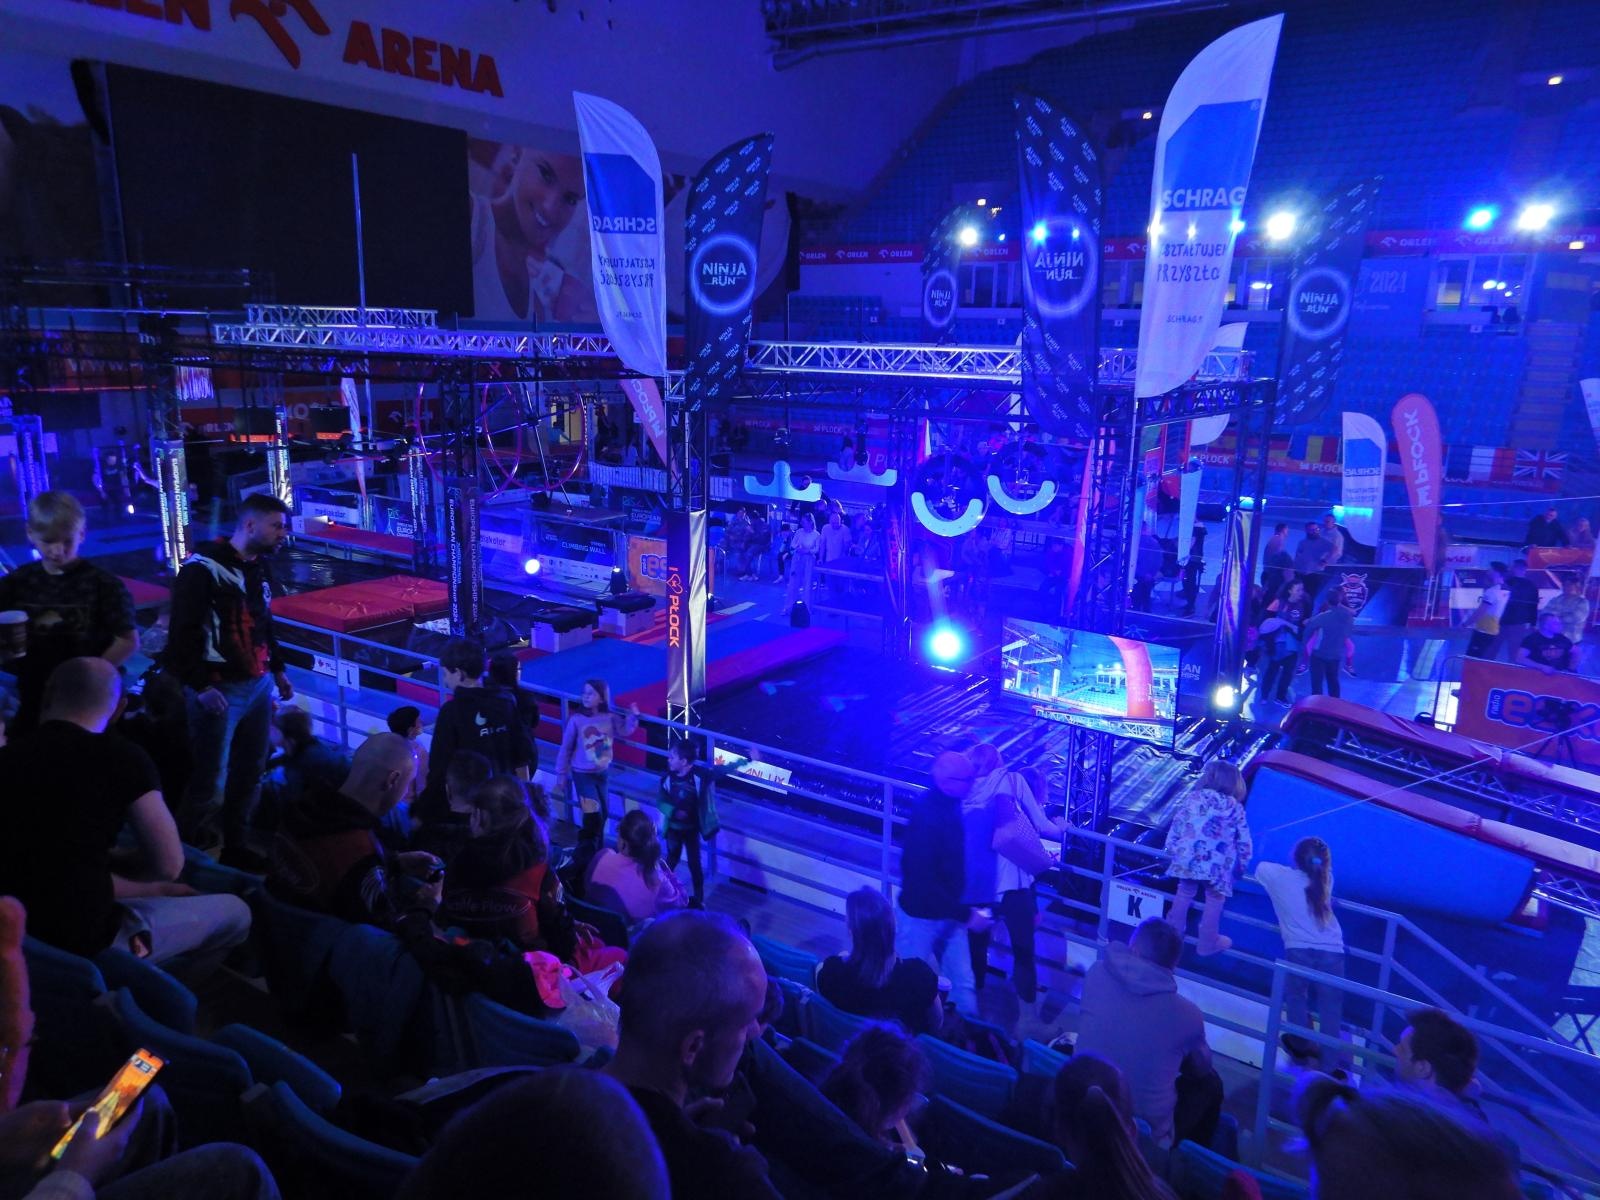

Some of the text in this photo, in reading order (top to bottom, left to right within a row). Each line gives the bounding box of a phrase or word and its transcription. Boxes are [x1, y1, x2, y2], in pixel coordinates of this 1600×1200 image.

[343, 20, 505, 98] ARENA
[1162, 187, 1245, 208] SCHRAG
[702, 262, 747, 276] NINJA
[712, 277, 736, 287] RUN
[1300, 291, 1339, 306] NINJA
[1306, 304, 1330, 314] RUN
[448, 498, 456, 542] EUROPEAN
[561, 540, 589, 552] CLIMBING
[588, 544, 606, 555] WALL
[1127, 894, 1143, 919] K
